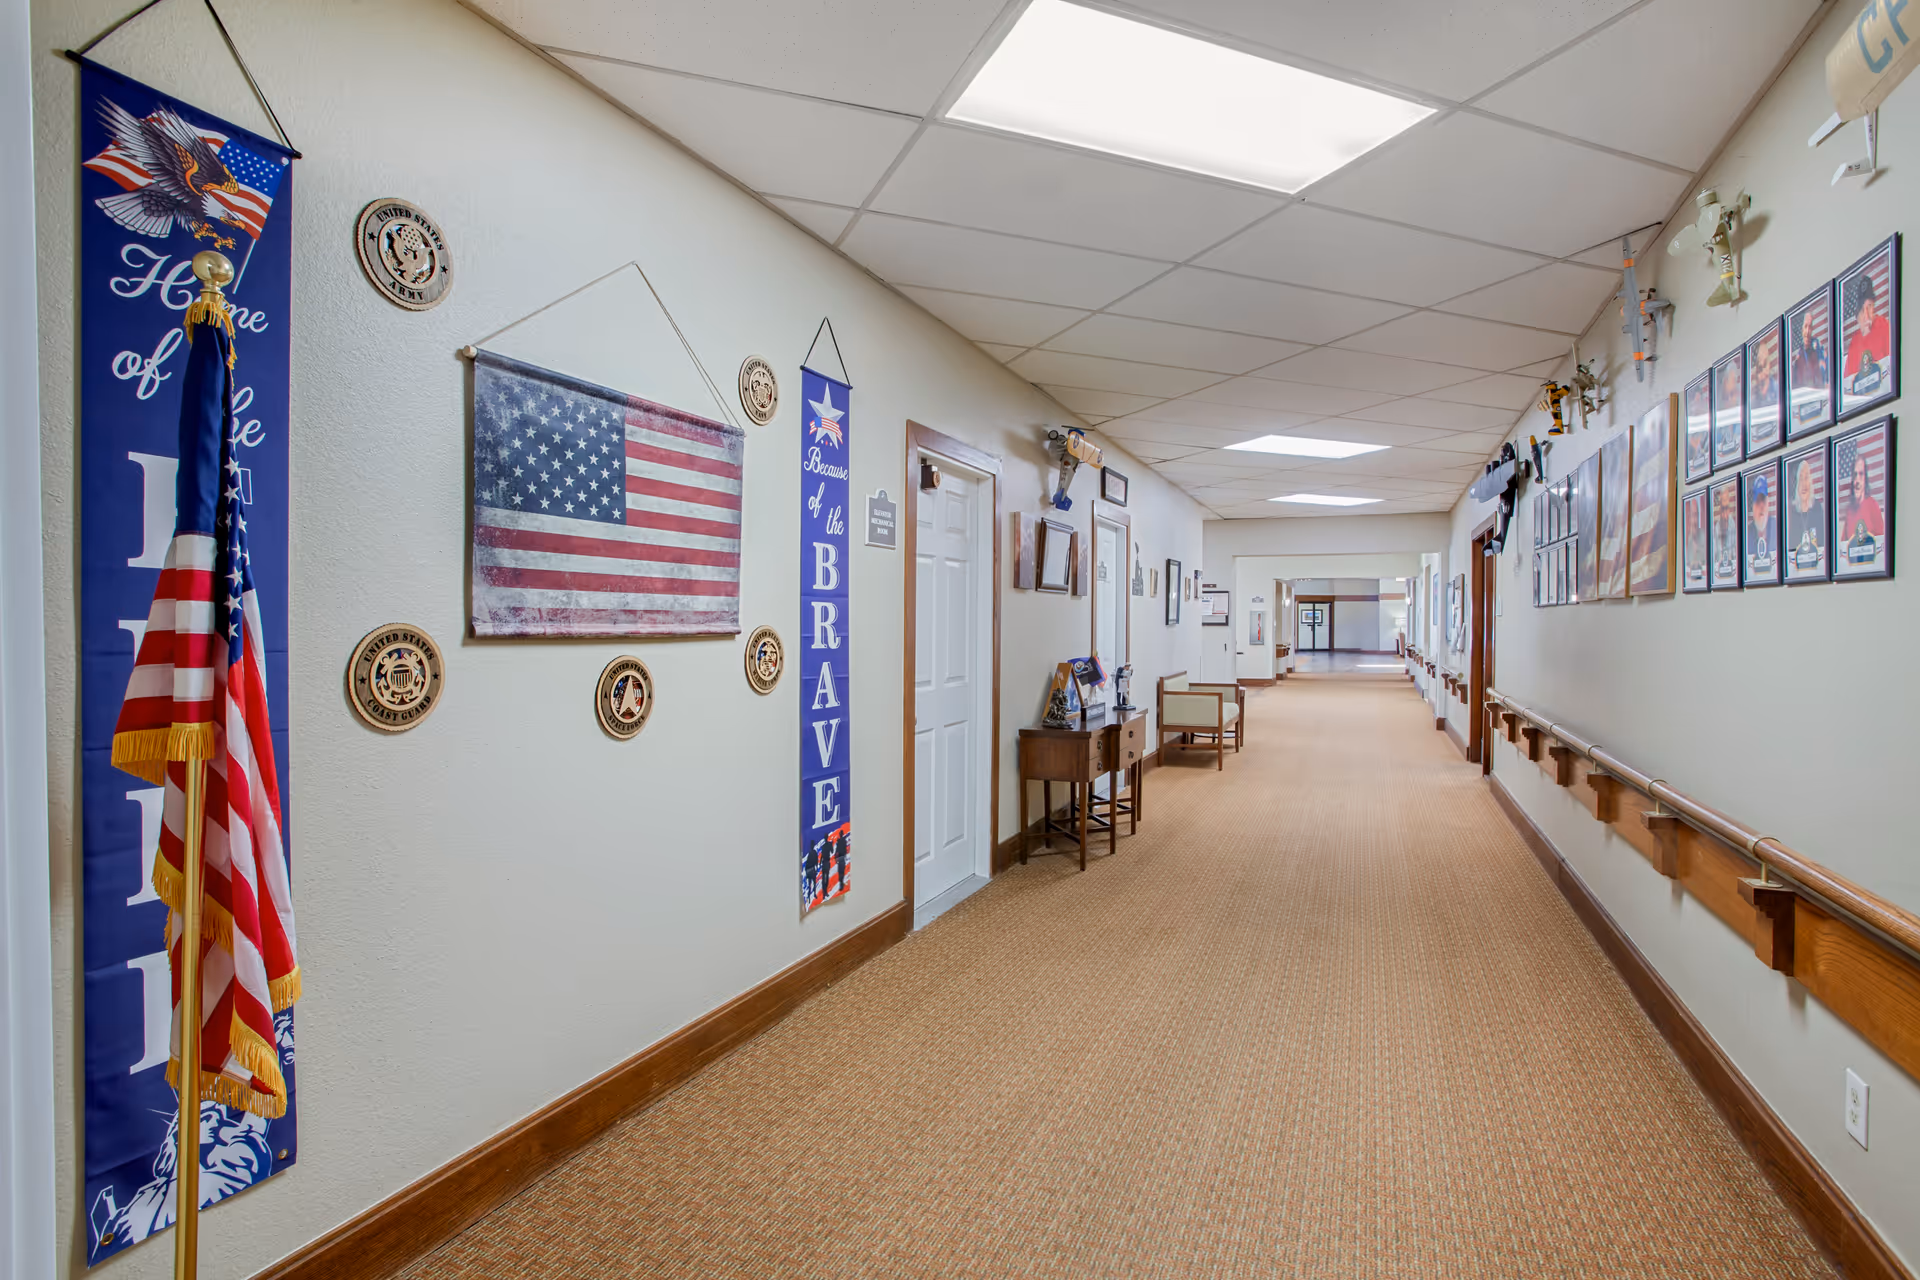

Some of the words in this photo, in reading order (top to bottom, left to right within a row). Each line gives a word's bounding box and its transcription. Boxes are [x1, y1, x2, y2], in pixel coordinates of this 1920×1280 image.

[376, 207, 412, 222] UNITED
[414, 214, 444, 251] STATES
[110, 243, 269, 333] Hme
[389, 280, 424, 300] ARMY
[112, 328, 183, 400] of
[746, 361, 761, 375] UNITED
[804, 446, 849, 481] Because
[808, 482, 826, 518] of
[826, 505, 845, 535] the
[364, 633, 399, 663] UNITED
[402, 632, 435, 660] STATES
[609, 662, 630, 680] UNITED
[630, 662, 648, 680] STATES
[811, 541, 842, 829] BRAVE
[367, 699, 399, 721] COAST
[401, 696, 431, 720] GUARD
